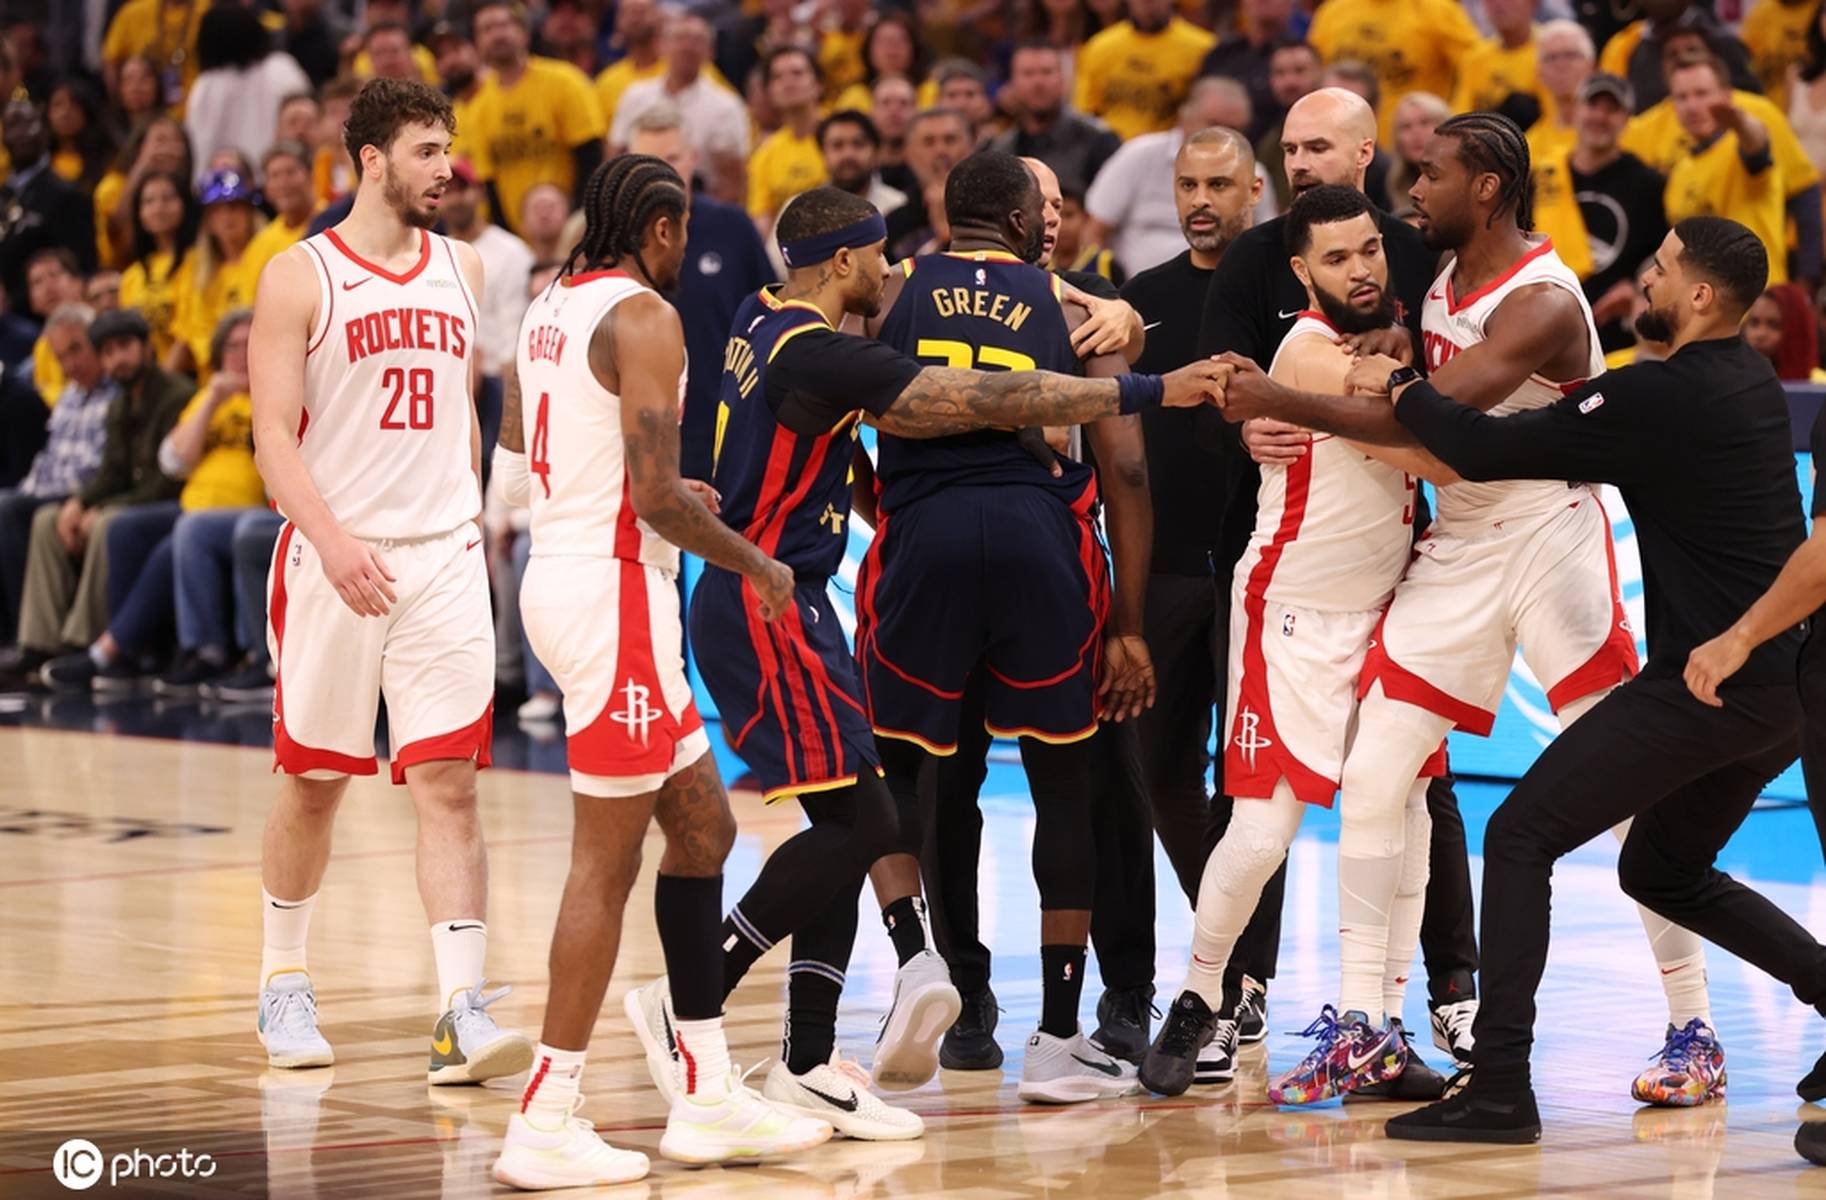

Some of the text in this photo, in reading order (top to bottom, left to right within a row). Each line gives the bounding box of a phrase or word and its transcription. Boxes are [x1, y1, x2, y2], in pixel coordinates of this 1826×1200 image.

[345, 307, 467, 364] ROCKETS
[931, 287, 1032, 332] GREEN
[528, 325, 568, 366] GREEN
[380, 367, 434, 430] 28
[531, 392, 551, 500] 4
